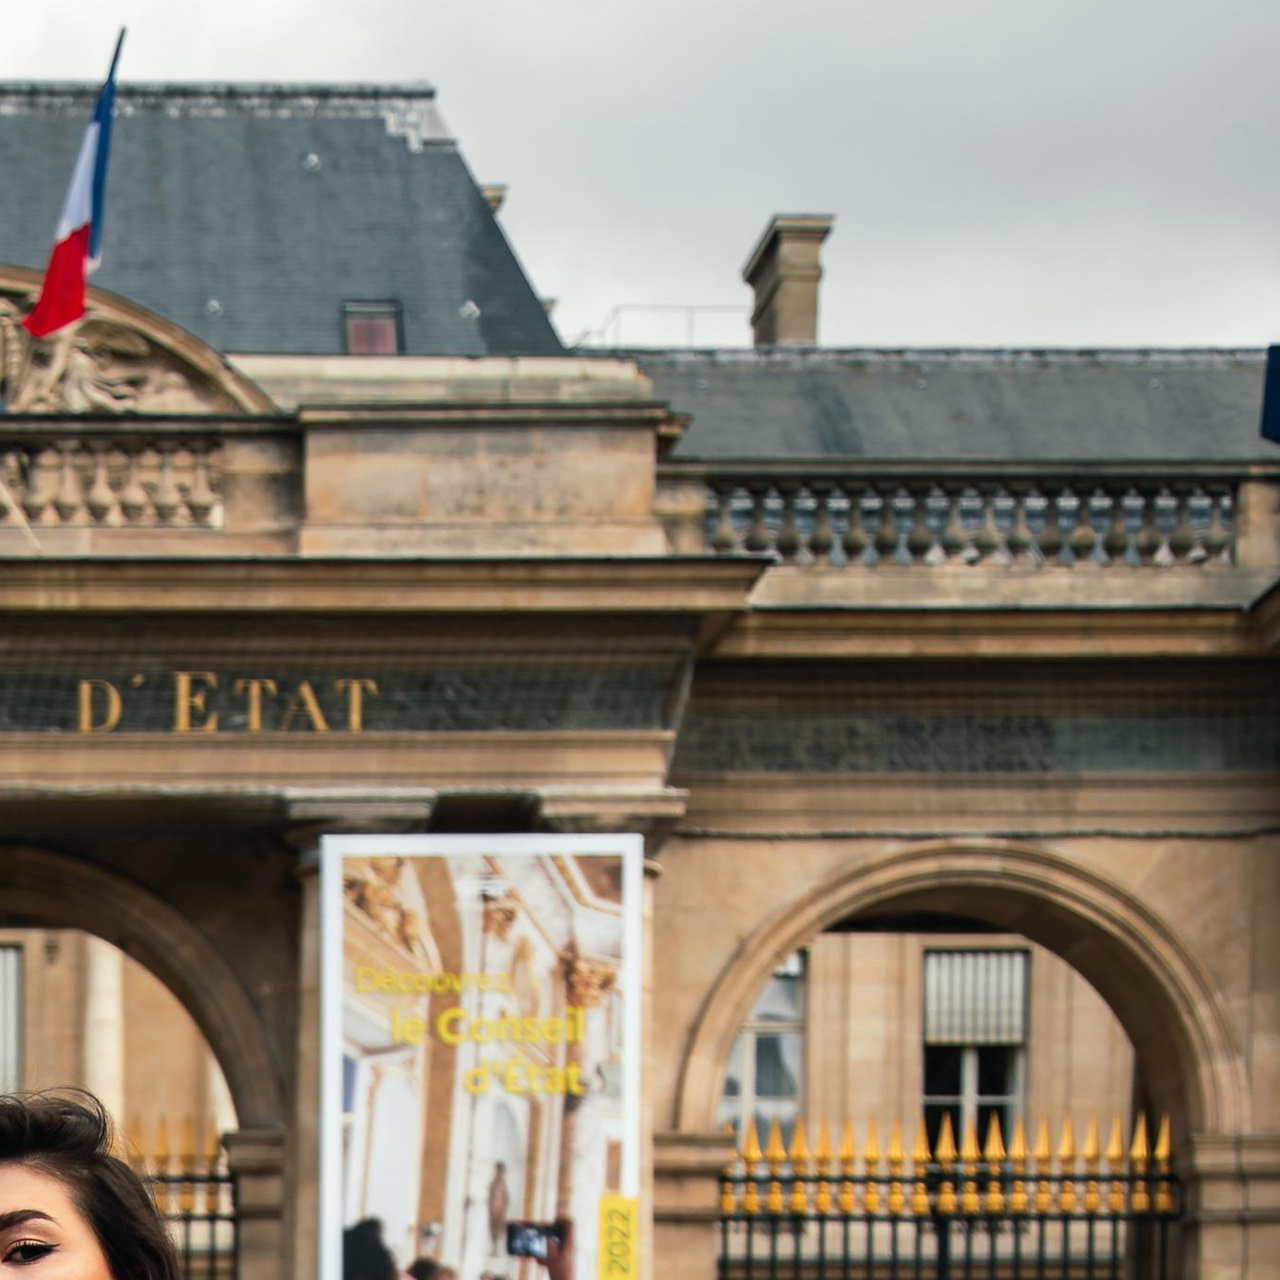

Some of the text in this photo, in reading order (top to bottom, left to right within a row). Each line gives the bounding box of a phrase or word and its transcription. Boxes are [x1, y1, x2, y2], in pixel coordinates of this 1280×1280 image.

[78, 670, 381, 734] D'ETAT
[390, 1004, 584, 1046] le Conseil
[463, 1052, 586, 1096] d'État
[607, 1207, 631, 1275] 2022
